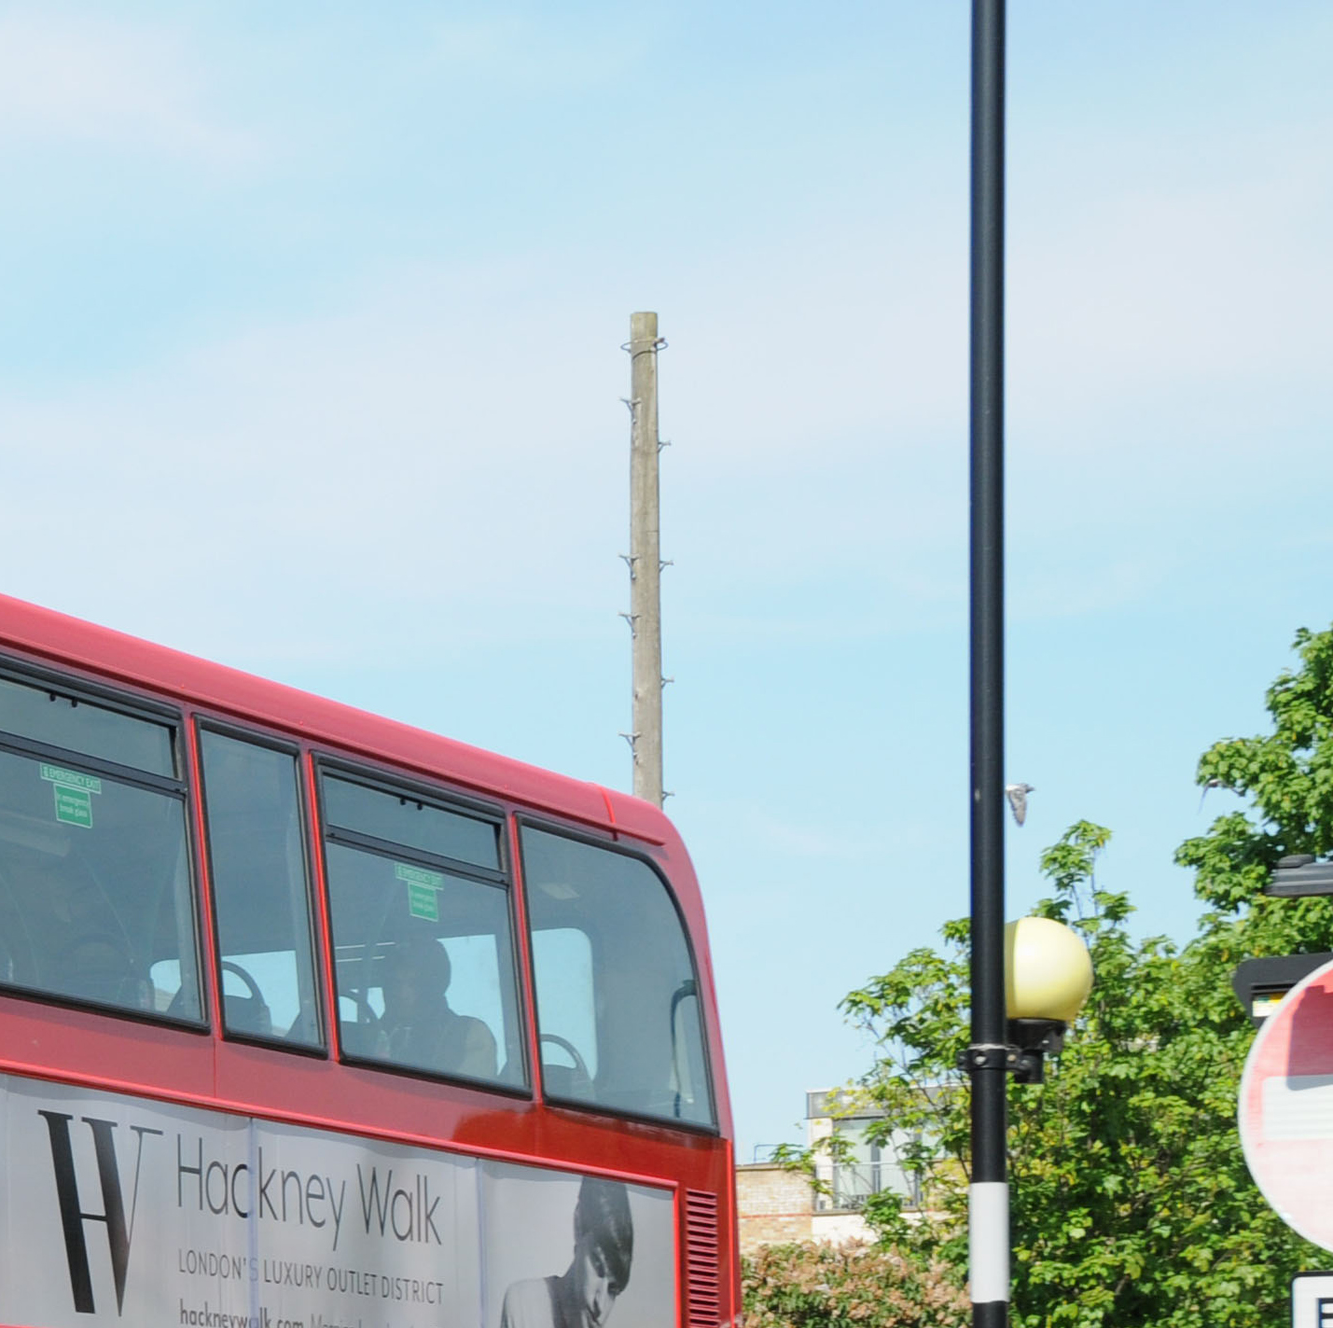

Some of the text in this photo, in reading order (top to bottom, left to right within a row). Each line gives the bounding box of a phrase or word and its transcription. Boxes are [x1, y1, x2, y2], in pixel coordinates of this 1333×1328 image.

[176, 1132, 442, 1252] Hackney Walk
[178, 1248, 444, 1305] LONDON'S LUXURY OUTLET DISTRICT
